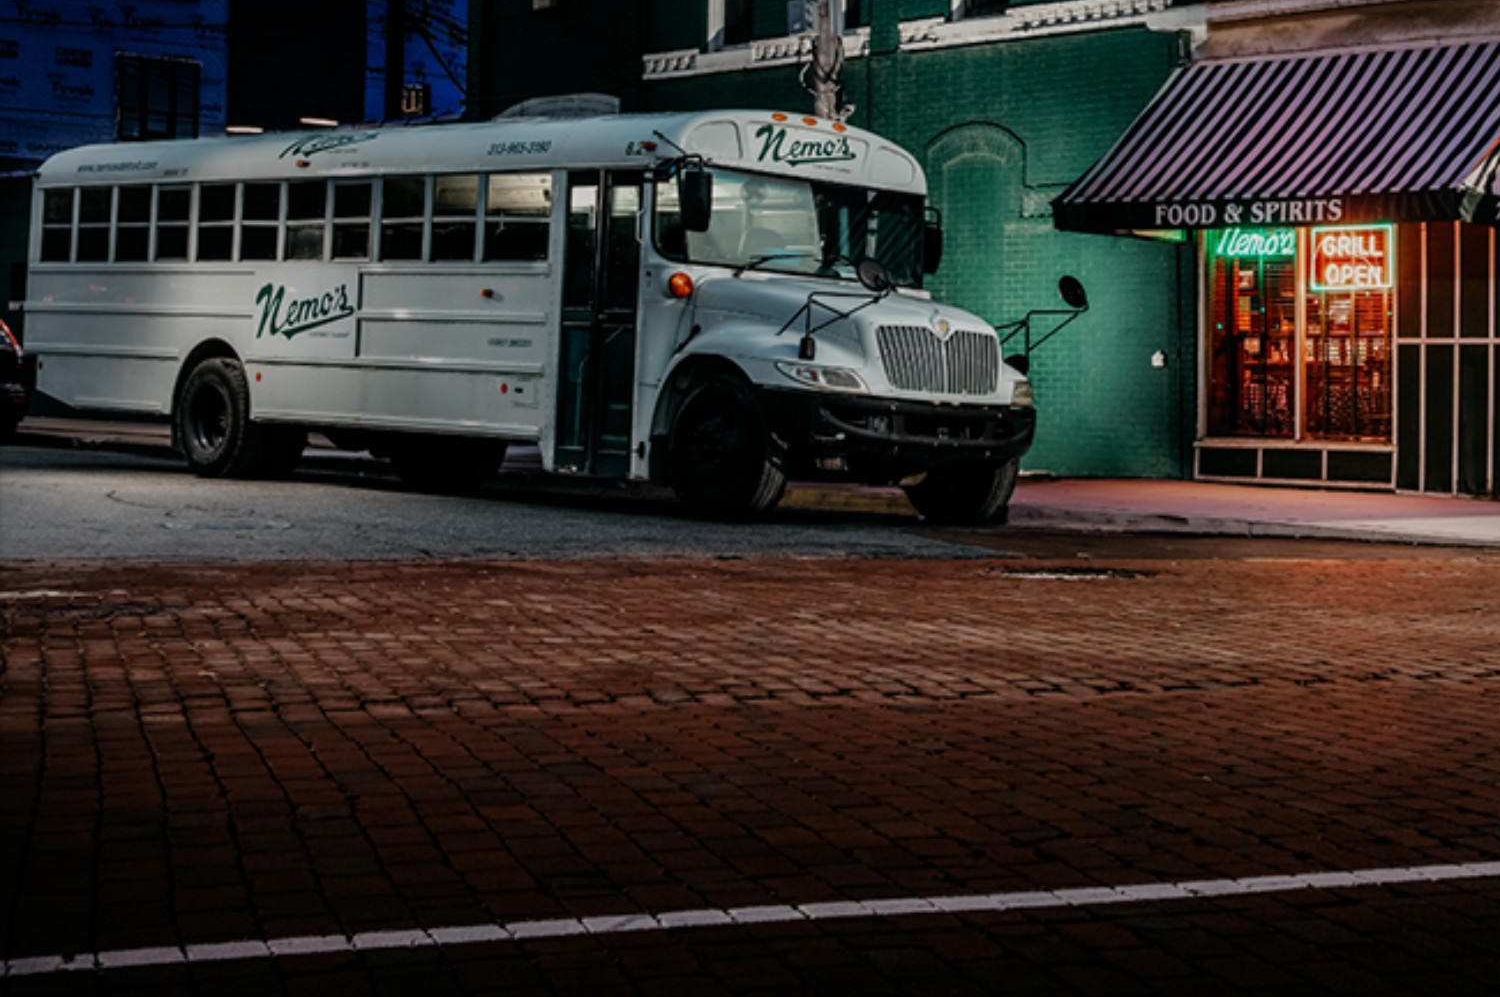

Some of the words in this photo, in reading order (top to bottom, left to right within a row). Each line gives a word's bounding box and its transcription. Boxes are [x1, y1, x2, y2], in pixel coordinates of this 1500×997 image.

[755, 124, 857, 167] Nemo's
[1155, 204, 1217, 226] FOOD
[1224, 203, 1244, 224] &
[1250, 199, 1344, 223] SPIRITS
[1216, 226, 1297, 256] Nemo's
[1321, 234, 1384, 258] GRILL
[1324, 262, 1384, 287] OPEN
[255, 282, 356, 341] Nemo's
